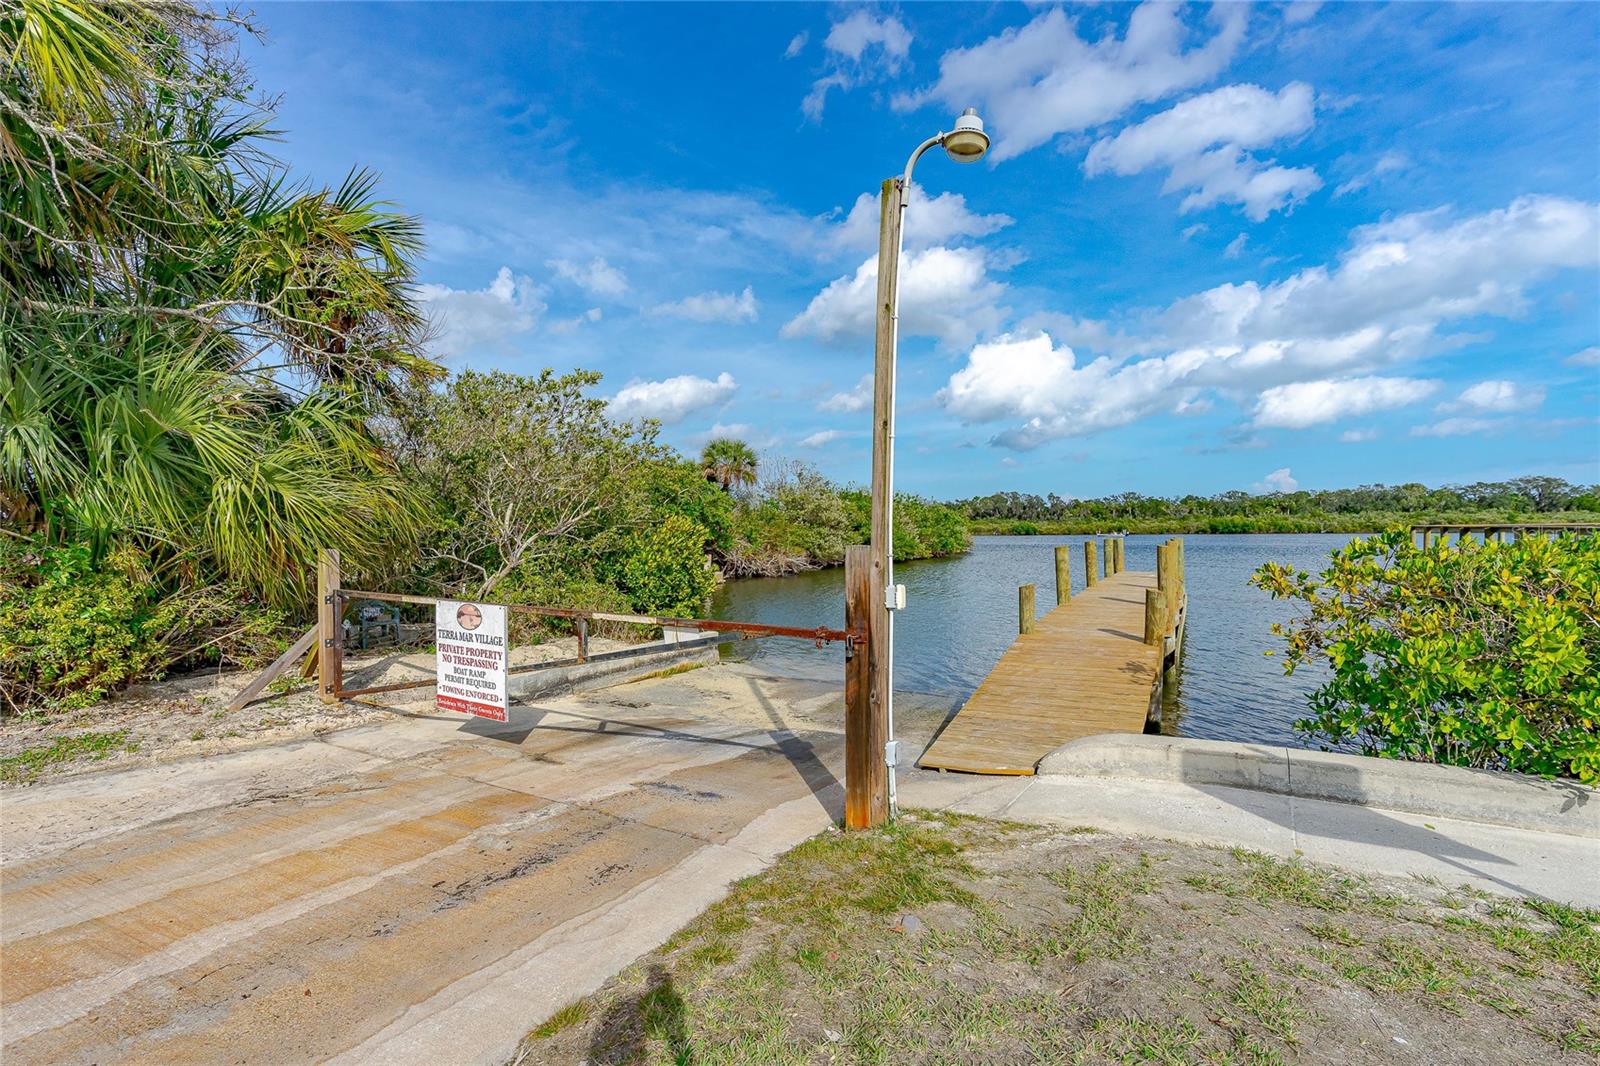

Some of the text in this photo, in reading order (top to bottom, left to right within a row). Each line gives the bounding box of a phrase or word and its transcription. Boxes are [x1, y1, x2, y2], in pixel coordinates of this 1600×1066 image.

[438, 629, 503, 646] TERRA MAR VILLAGE
[438, 643, 503, 660] PRIVATE PROPERTY
[442, 654, 498, 671] NO TRESPASSING
[453, 667, 486, 679] BOAT RAMP
[444, 674, 497, 690] PERMIT REQUIRED
[442, 685, 499, 703] TOWING ENFORCED
